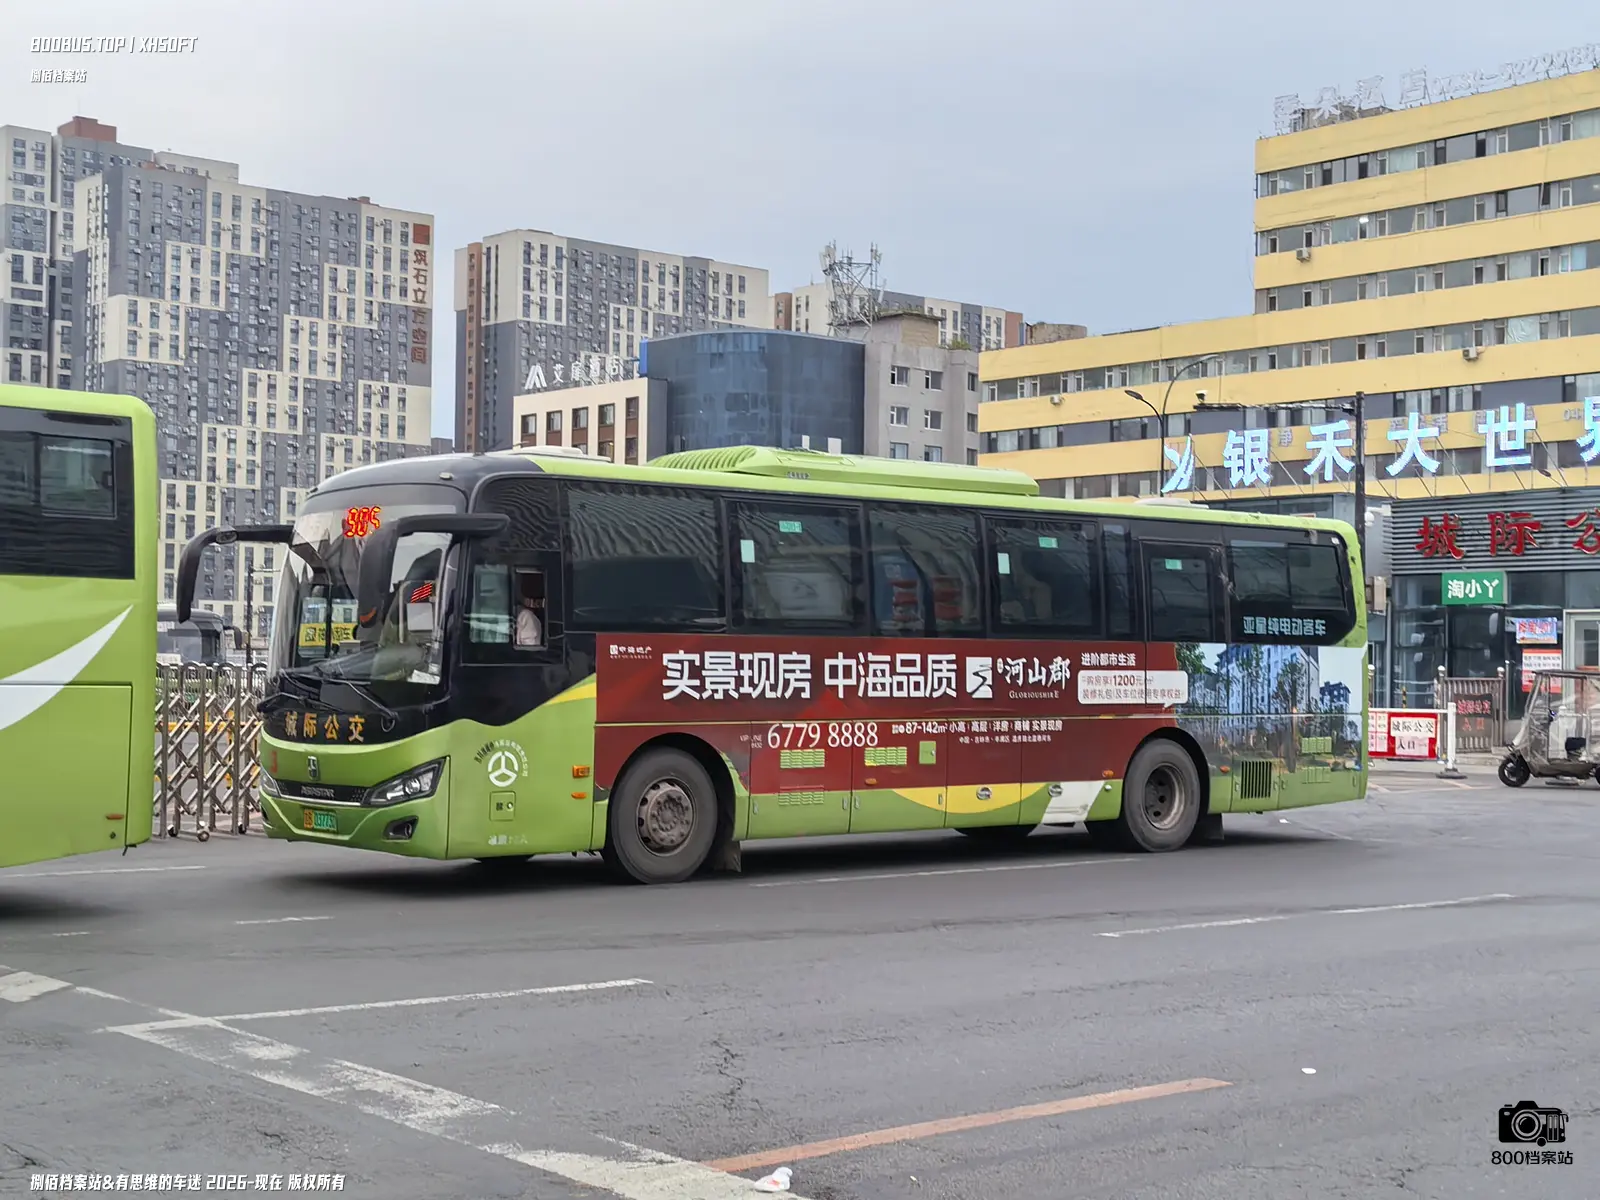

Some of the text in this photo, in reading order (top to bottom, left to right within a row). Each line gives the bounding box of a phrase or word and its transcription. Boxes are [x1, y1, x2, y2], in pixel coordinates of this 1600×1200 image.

[1415, 507, 1600, 559] 城际公
[1243, 616, 1326, 636] 亚星纯电动客车
[662, 650, 957, 700] 实景现房 中海品质
[285, 711, 365, 742] 城际公交
[767, 723, 821, 749] 6779
[828, 722, 879, 748] 8888
